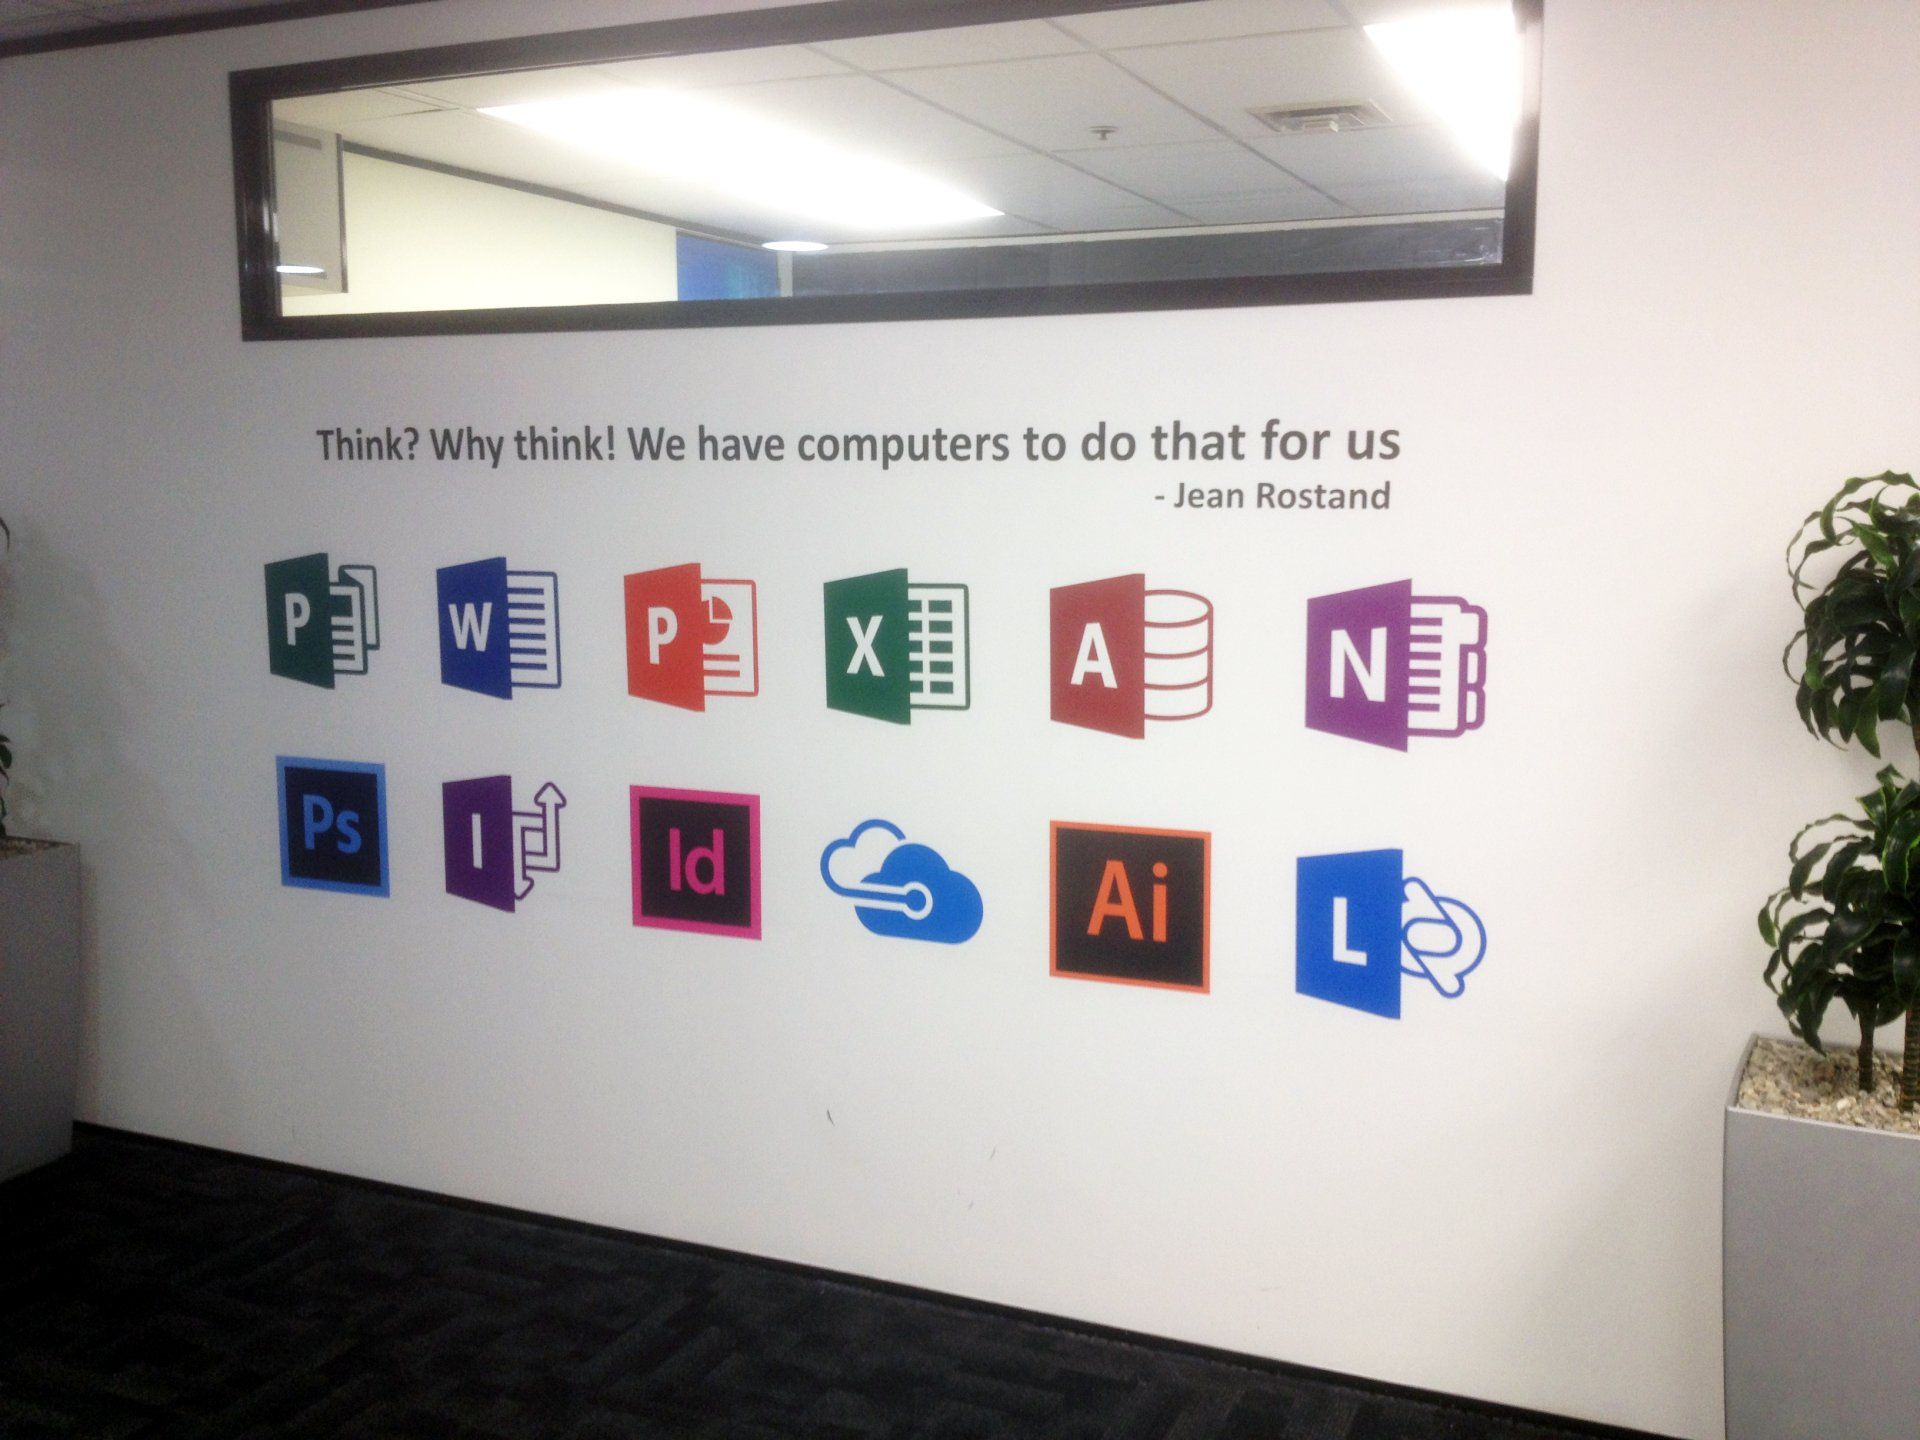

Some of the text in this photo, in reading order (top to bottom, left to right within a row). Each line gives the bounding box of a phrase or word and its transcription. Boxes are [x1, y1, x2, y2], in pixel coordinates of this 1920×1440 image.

[316, 419, 1402, 470] Think? Why think! We have computers to do that for us
[1174, 482, 1244, 509] Jean
[1257, 481, 1391, 510] Rostand
[285, 592, 311, 646] P
[448, 602, 492, 652] W
[647, 606, 678, 665] P
[846, 615, 886, 677] X
[1070, 621, 1118, 689] A
[1329, 627, 1387, 703] N
[302, 794, 363, 854] Ps
[669, 827, 726, 896] Id
[1086, 859, 1168, 943] Ai
[1332, 896, 1367, 966] L
